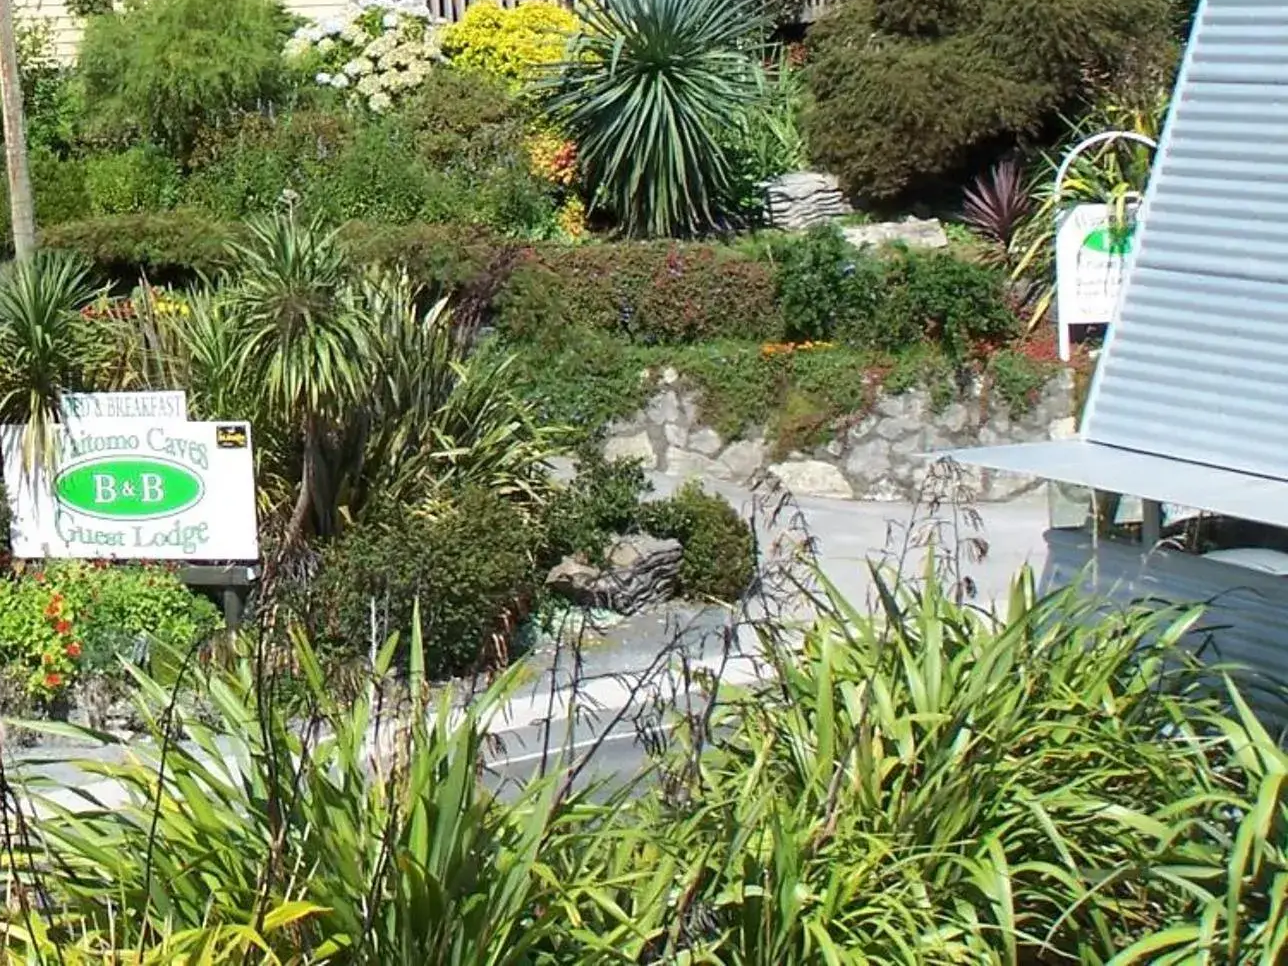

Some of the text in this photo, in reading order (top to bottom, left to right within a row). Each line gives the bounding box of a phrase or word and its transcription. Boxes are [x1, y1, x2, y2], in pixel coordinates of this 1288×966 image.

[107, 395, 182, 418] BREAKFAST
[146, 427, 210, 470] Caves
[93, 472, 165, 503] B & B
[55, 510, 211, 555] Guest Lodge
